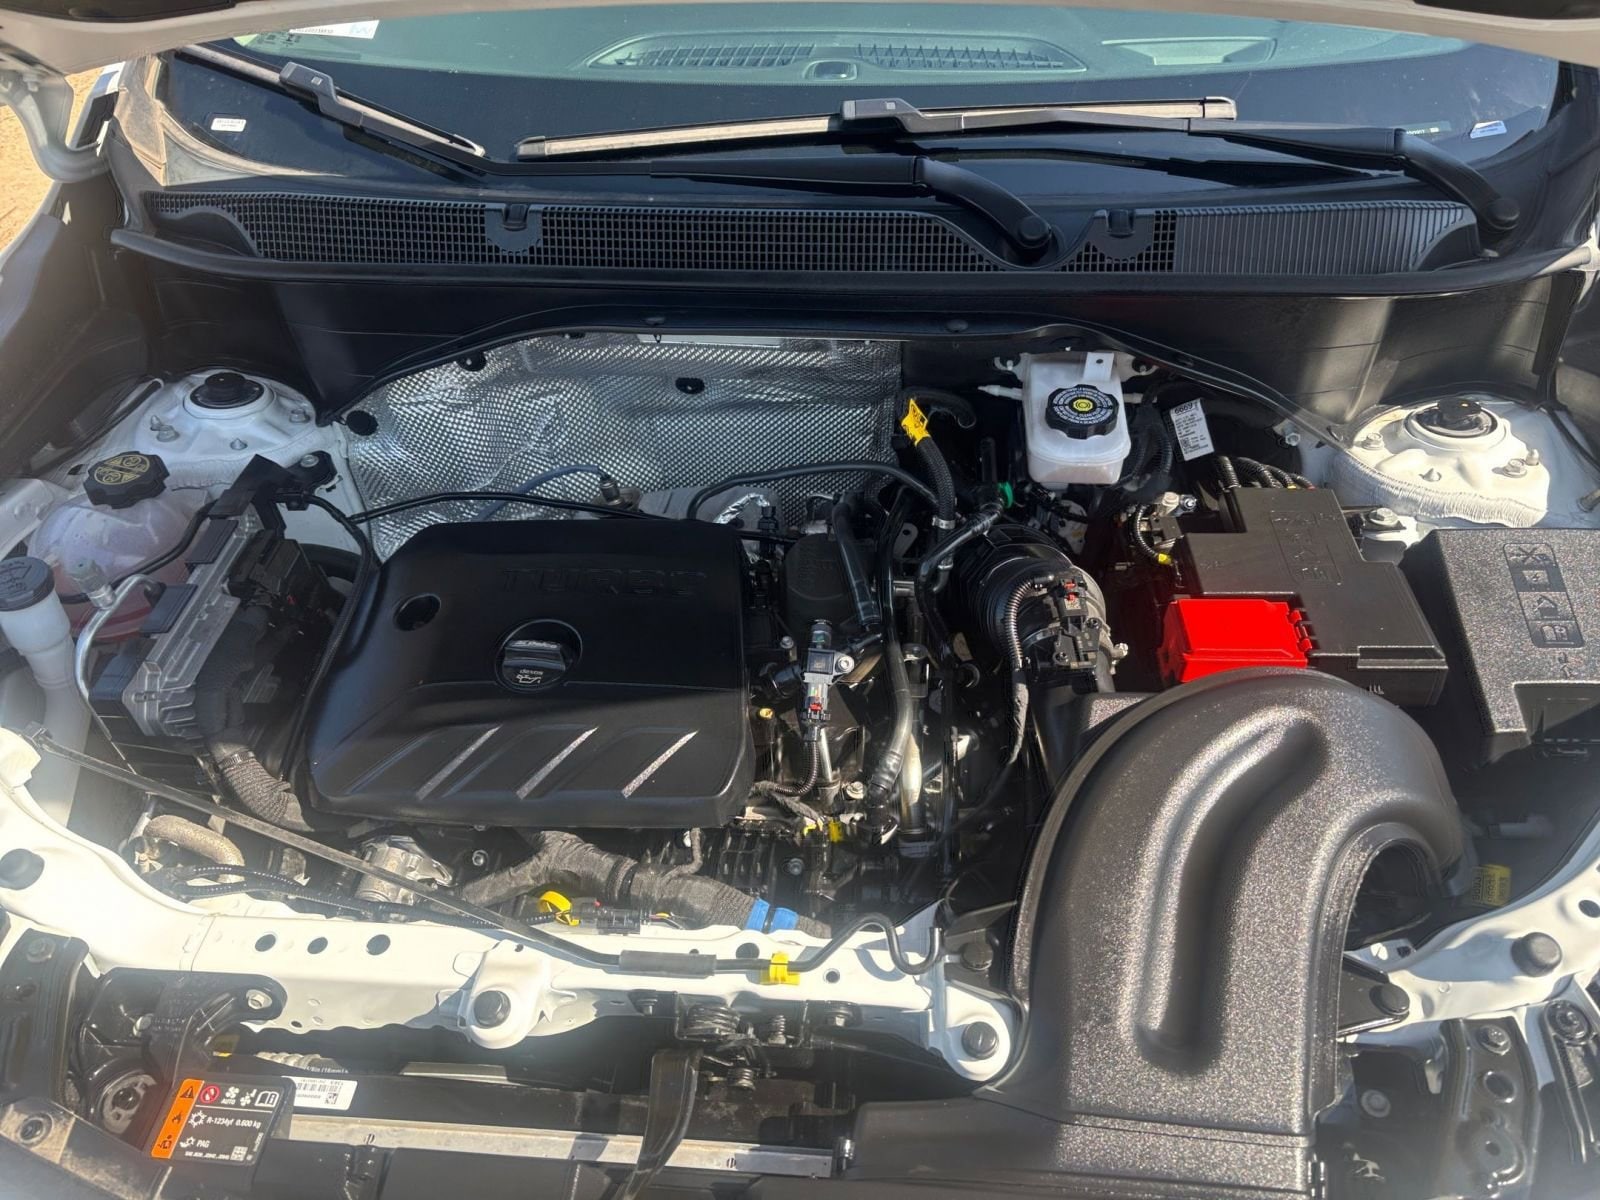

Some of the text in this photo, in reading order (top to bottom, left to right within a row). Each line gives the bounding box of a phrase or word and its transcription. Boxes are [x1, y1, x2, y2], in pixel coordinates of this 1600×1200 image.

[503, 567, 706, 595] TURBO
[253, 1121, 262, 1129] kg
[196, 1139, 211, 1148] PAG
